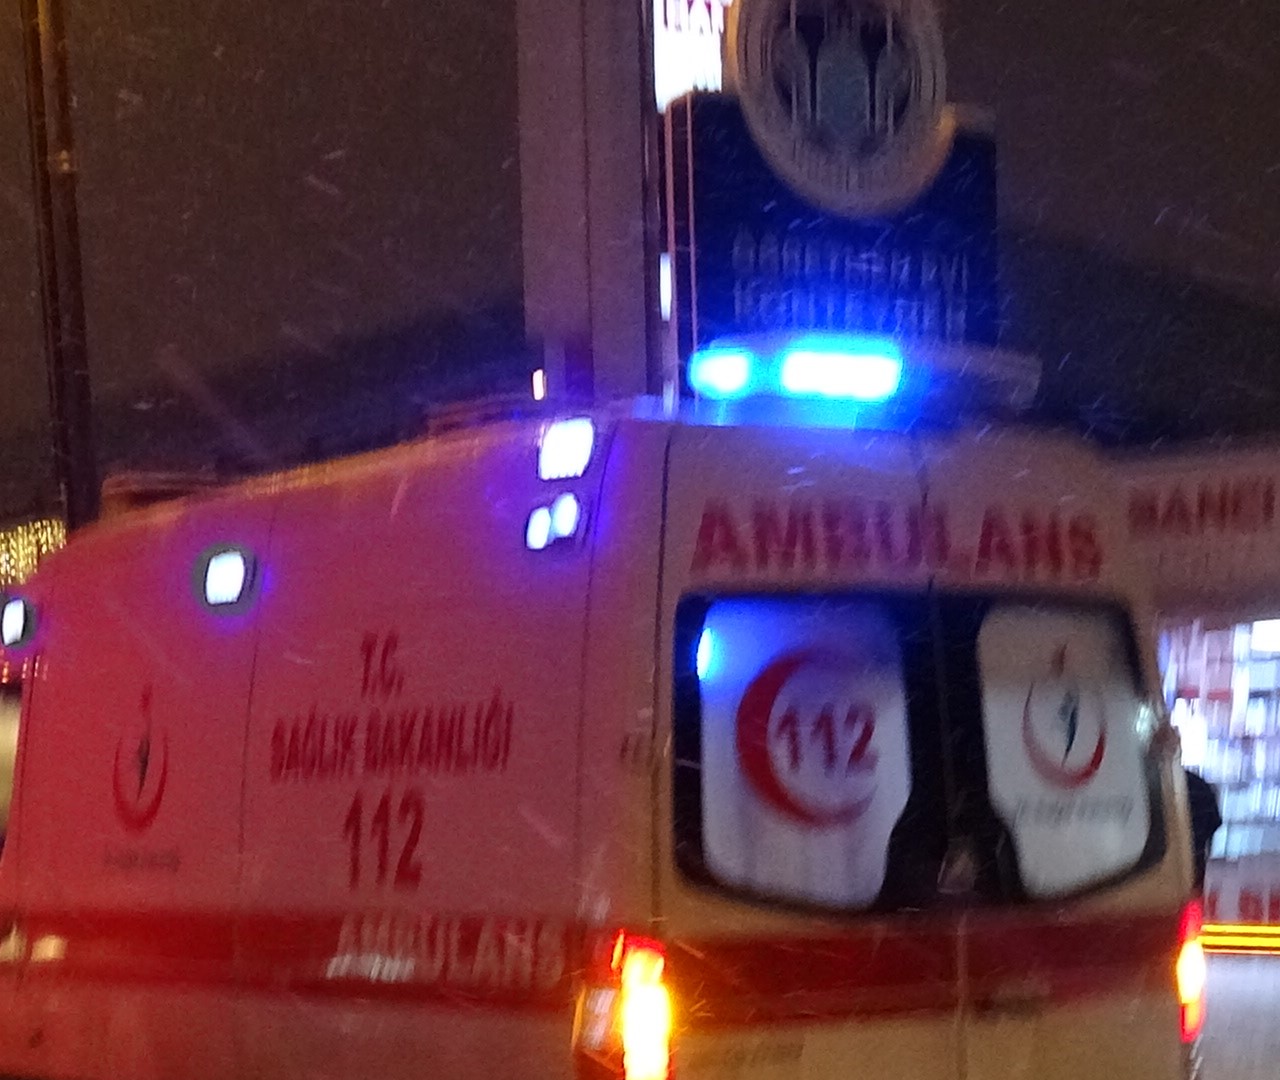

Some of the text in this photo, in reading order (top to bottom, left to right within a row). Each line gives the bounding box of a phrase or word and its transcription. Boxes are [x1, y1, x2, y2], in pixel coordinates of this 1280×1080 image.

[688, 499, 1105, 580] AMBULANS
[776, 701, 879, 778] 112
[344, 788, 425, 890] 112
